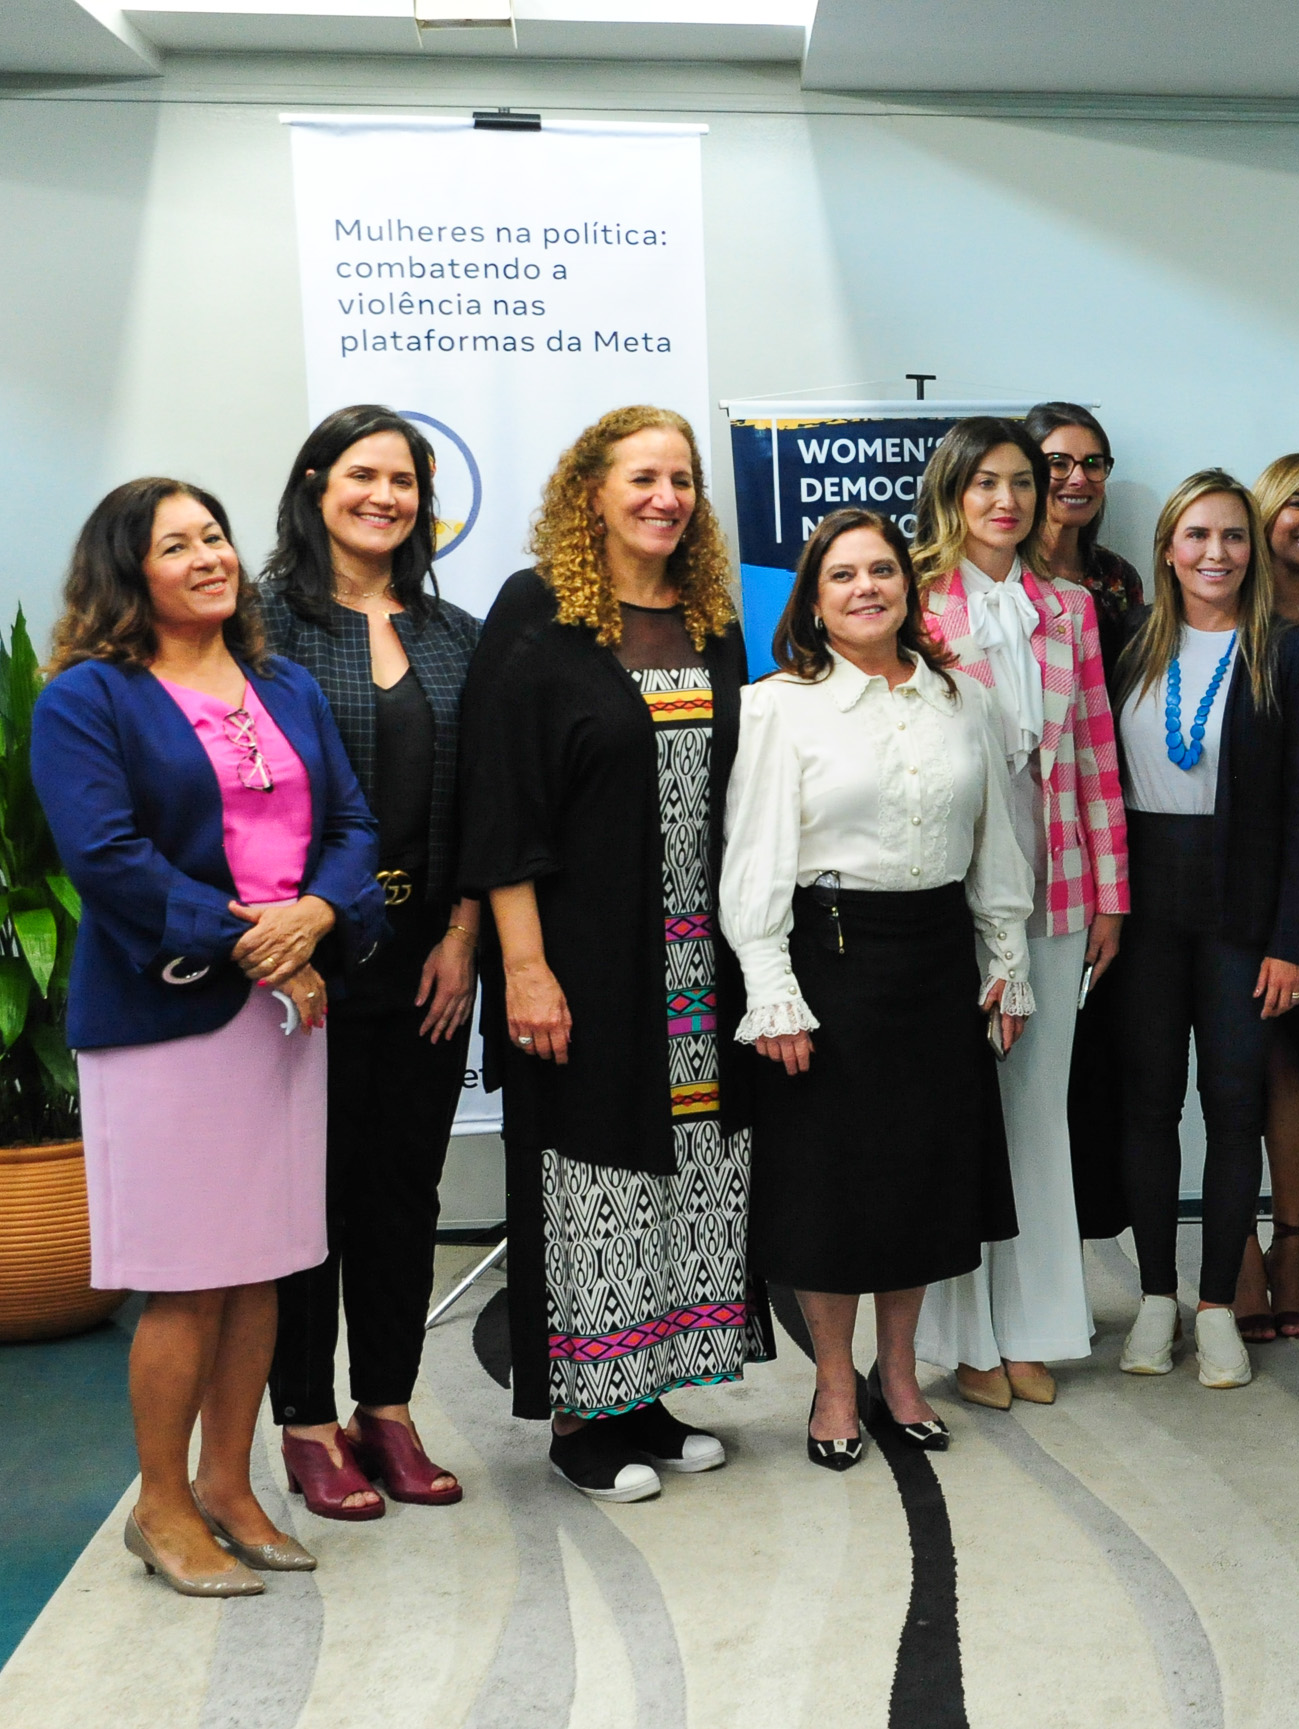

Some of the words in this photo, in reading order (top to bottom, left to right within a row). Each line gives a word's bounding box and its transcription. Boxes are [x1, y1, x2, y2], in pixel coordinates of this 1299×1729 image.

[335, 218, 485, 243] Mulheres
[496, 226, 531, 244] na
[543, 221, 668, 250] política:
[336, 255, 541, 280] combatendo
[552, 263, 568, 281] a
[337, 291, 482, 316] violência
[493, 299, 546, 317] nas
[341, 328, 535, 358] plataformas
[546, 329, 582, 353] da
[594, 330, 672, 353] Meta
[797, 437, 945, 464] WOMEN'
[800, 475, 926, 503] DEMOC
